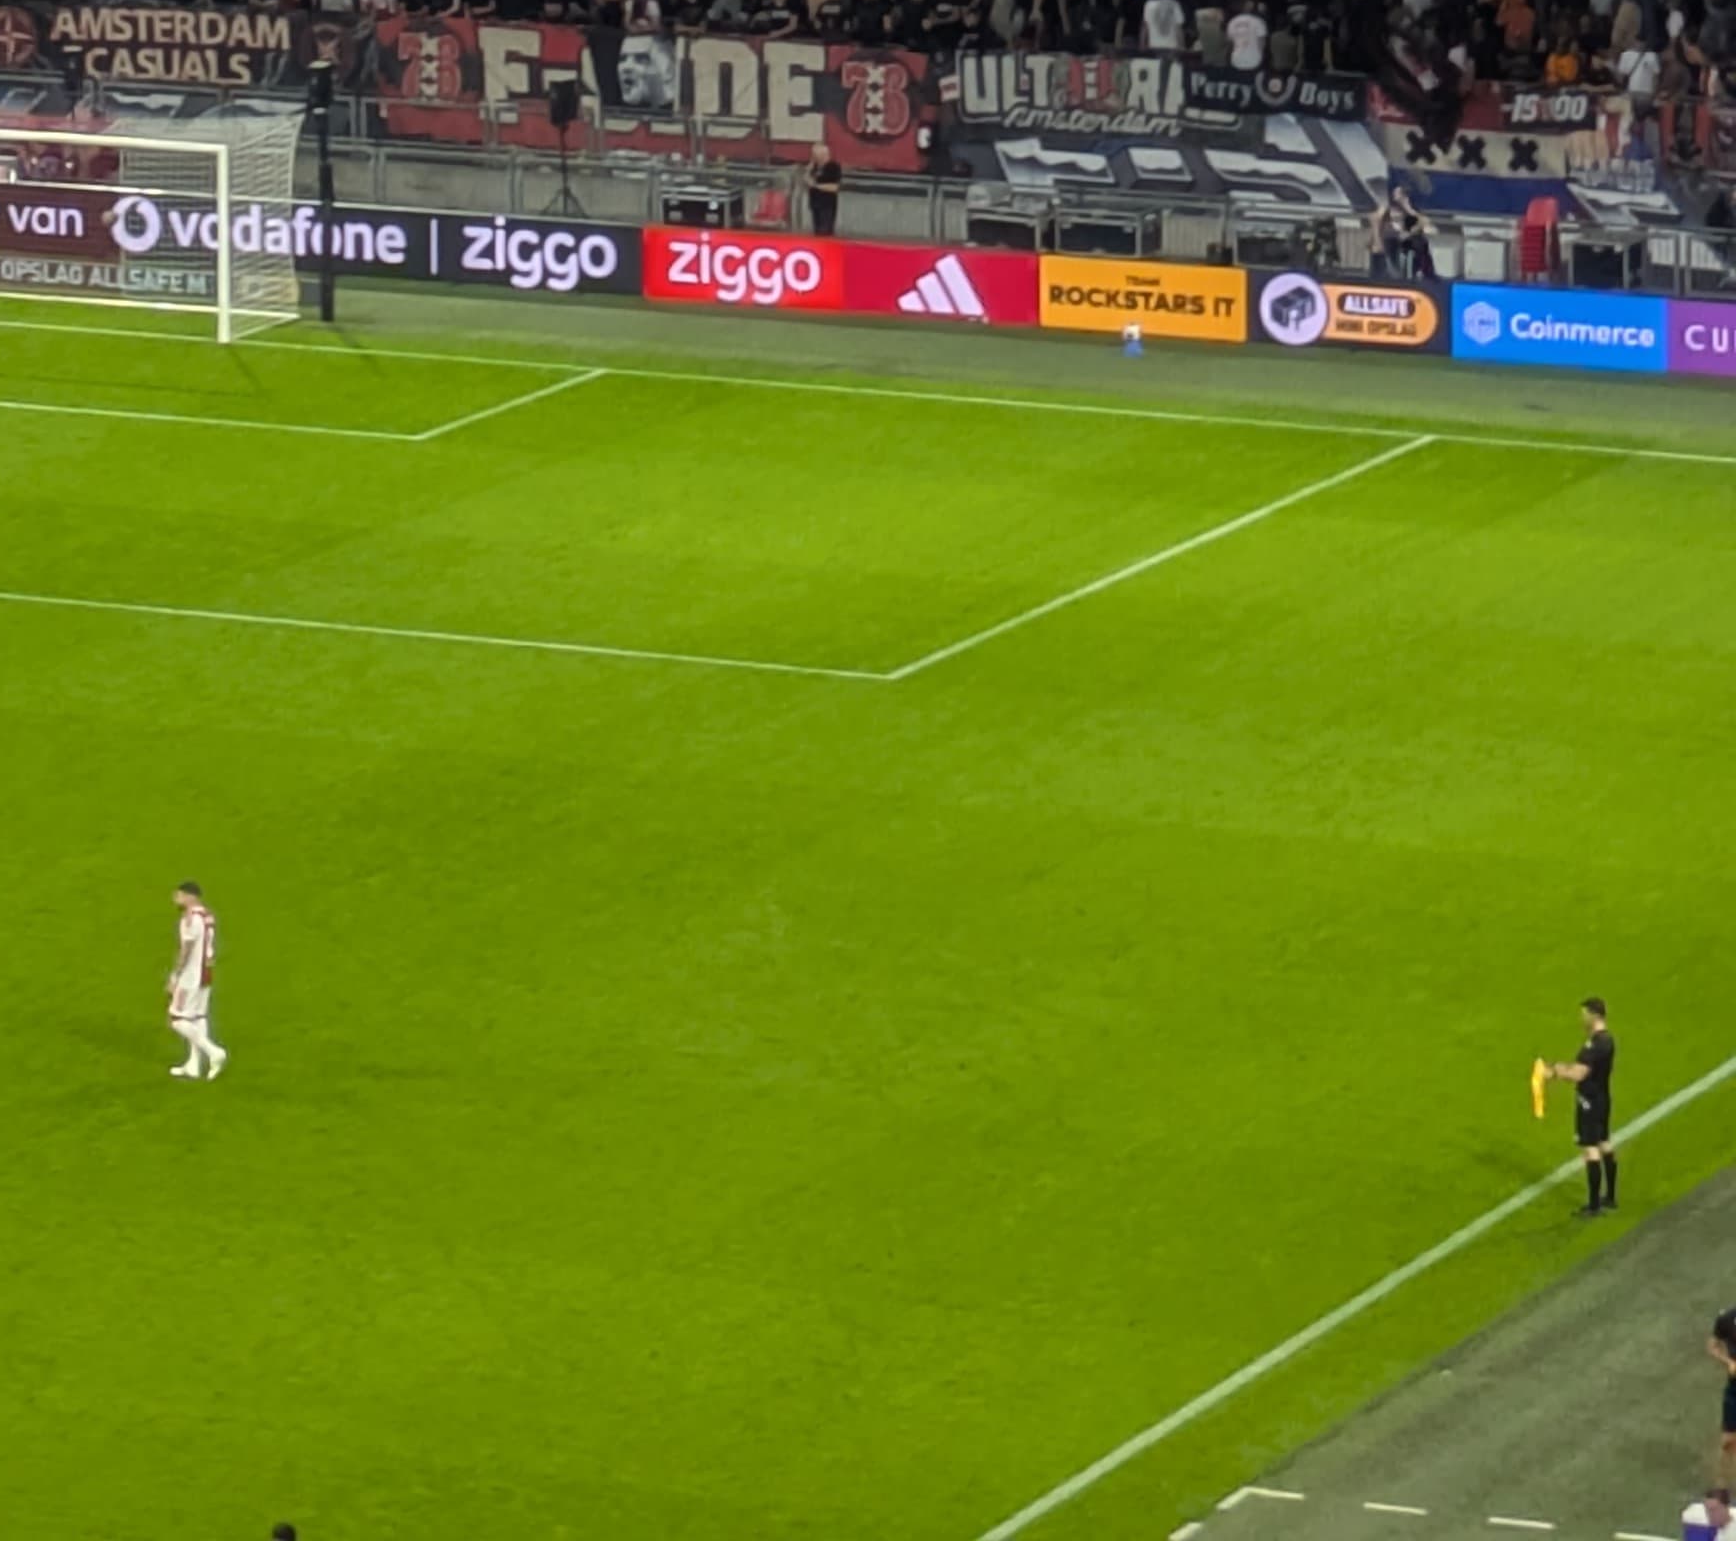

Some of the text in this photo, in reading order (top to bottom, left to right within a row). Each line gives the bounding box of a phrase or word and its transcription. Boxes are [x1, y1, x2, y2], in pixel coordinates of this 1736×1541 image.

[49, 5, 290, 51] AMSTERDAM
[84, 47, 251, 86] CASUALS
[1189, 71, 1253, 109] Perry
[1299, 80, 1356, 115] Boys
[7, 202, 85, 239] van
[1, 257, 86, 286] OPSLAG
[460, 215, 619, 291] ziggo
[667, 232, 821, 304] ziggo
[1048, 285, 1236, 318] ROCKSTARS IT
[1343, 295, 1410, 317] ALLSAFE
[1510, 312, 1655, 348] Coinmerce
[1683, 324, 1736, 354] CU
